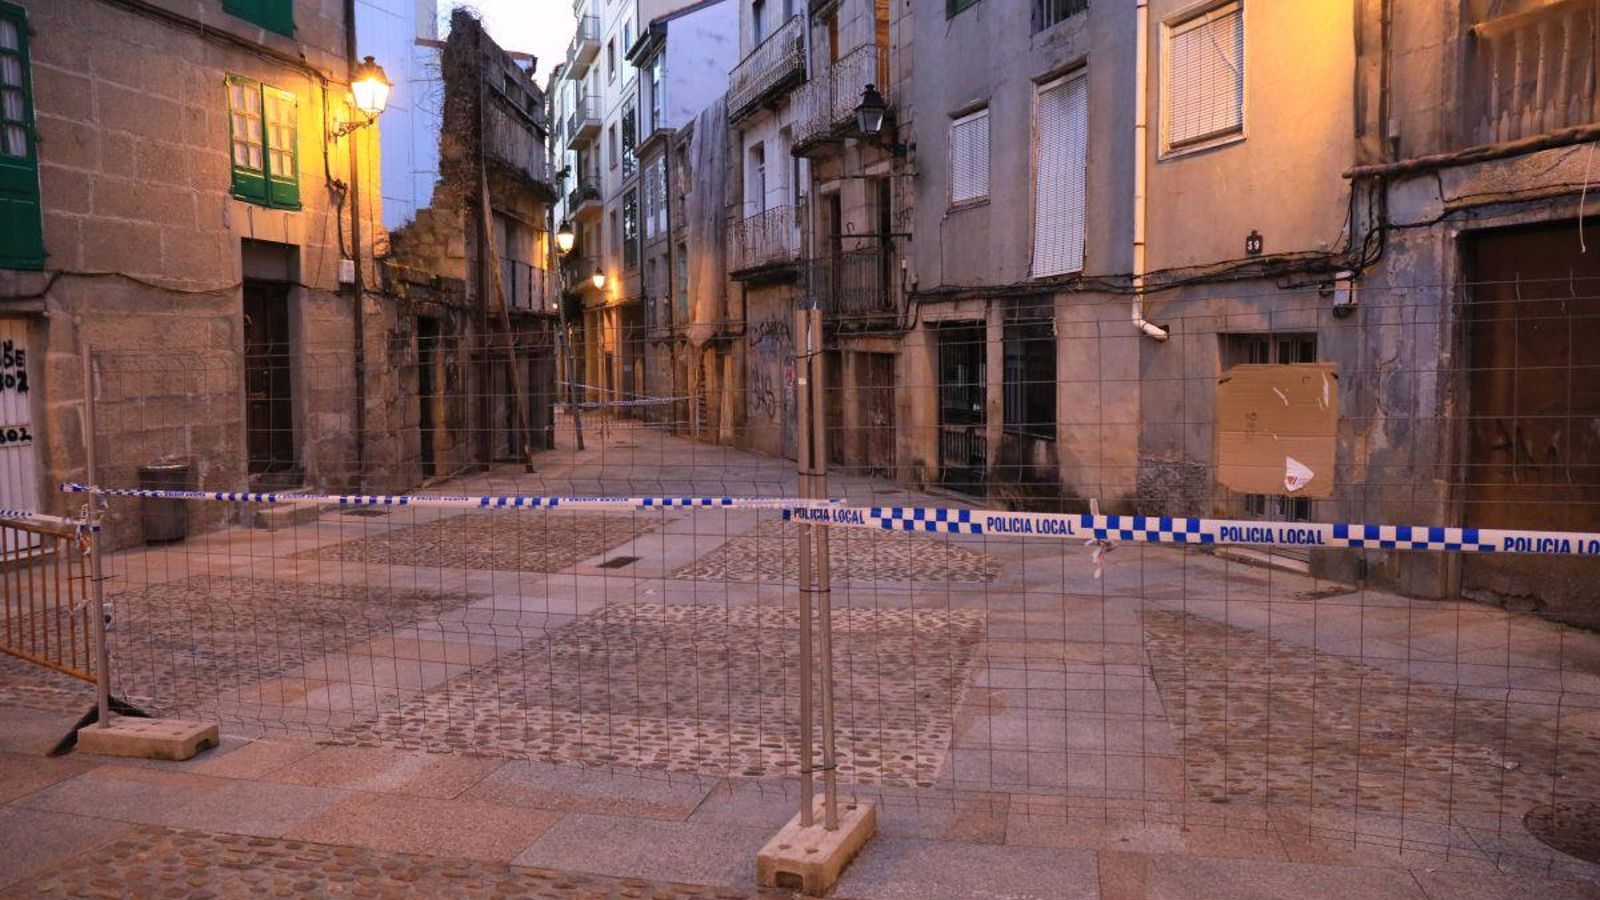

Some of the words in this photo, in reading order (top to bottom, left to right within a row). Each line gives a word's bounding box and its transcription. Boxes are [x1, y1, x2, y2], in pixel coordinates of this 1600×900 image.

[794, 507, 830, 521] POLICIA
[833, 509, 865, 524] LOCAL
[987, 516, 1033, 533] POLICIA
[1036, 519, 1075, 535] LOCAL
[1220, 526, 1274, 543] POLICIA
[1279, 529, 1325, 545] LOCAL
[1504, 537, 1571, 553] POLICIA
